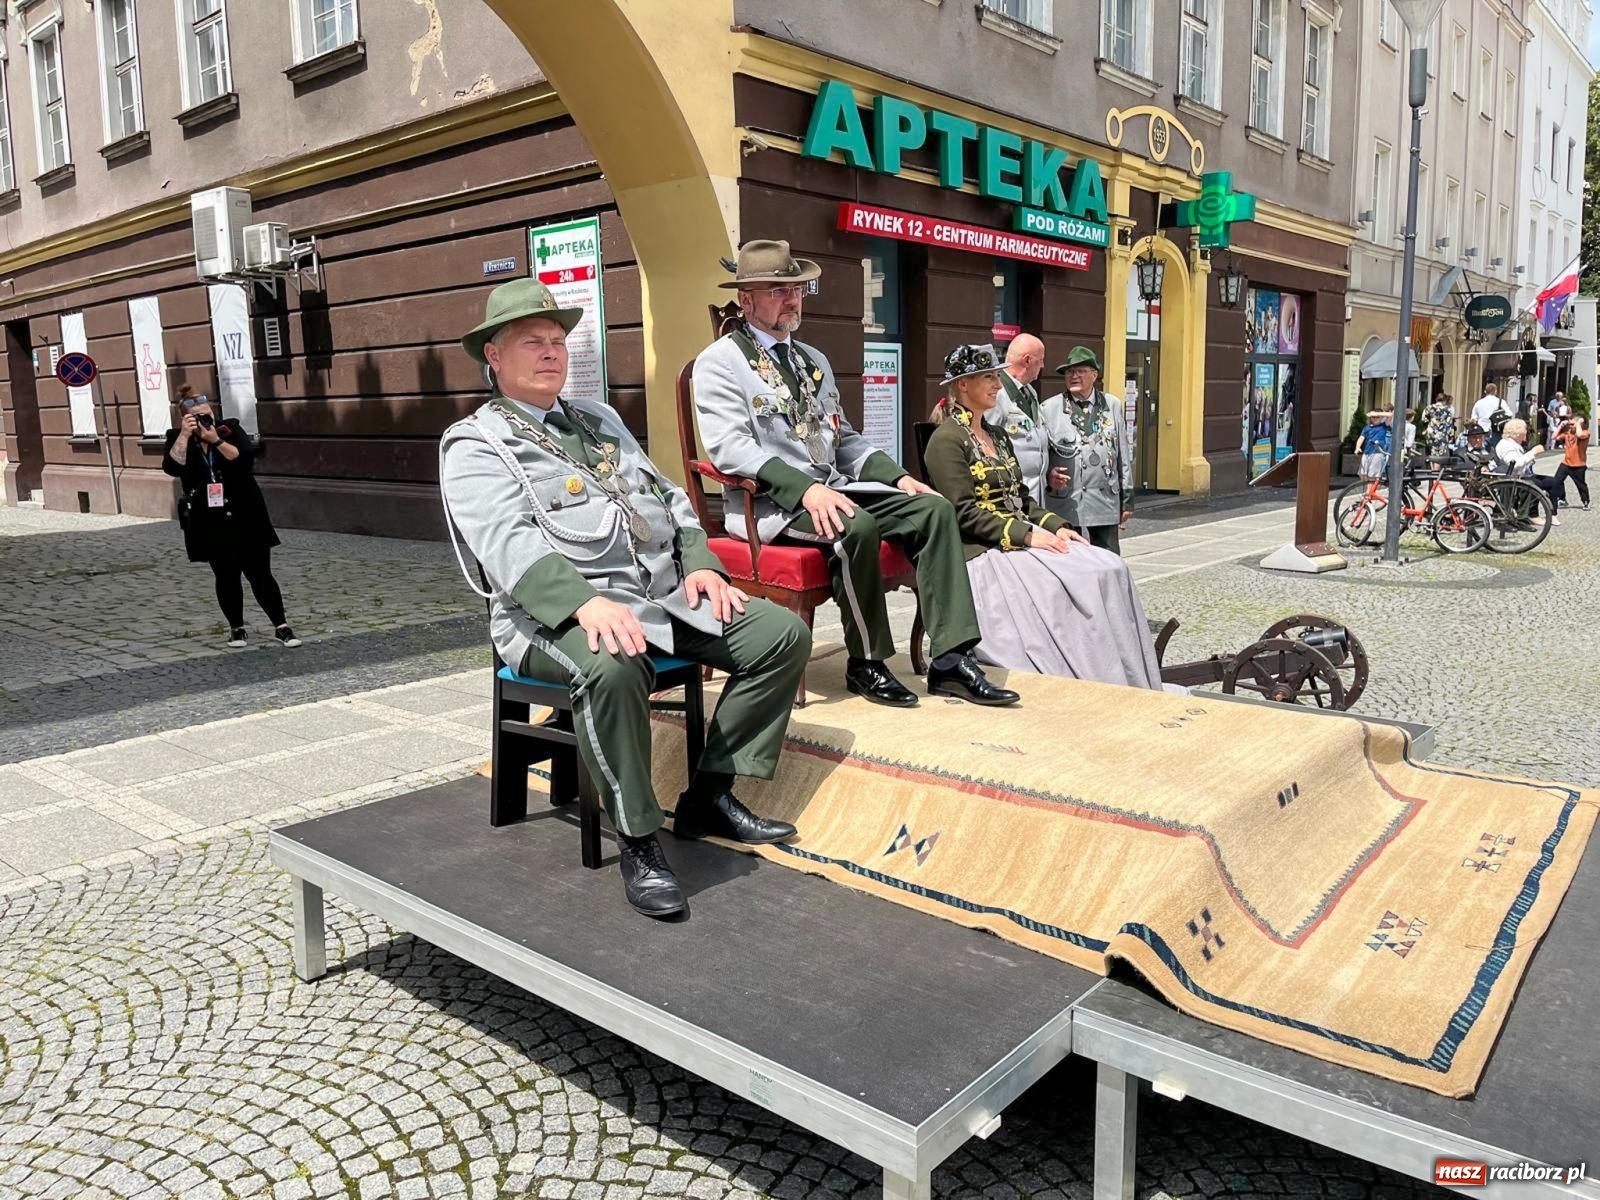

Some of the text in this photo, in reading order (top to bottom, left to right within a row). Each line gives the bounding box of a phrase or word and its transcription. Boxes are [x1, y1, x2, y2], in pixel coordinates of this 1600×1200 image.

[801, 79, 1108, 221] APTEKA
[853, 209, 904, 234] RYNEK
[907, 219, 923, 237] 12
[933, 224, 993, 249] CENTRUM
[995, 236, 1088, 266] FARMACEUTYCZNE
[1027, 213, 1106, 242] POD RÓŻAMI
[551, 238, 594, 256] APTEKA
[559, 269, 575, 283] 24h
[864, 360, 896, 369] APTEKA
